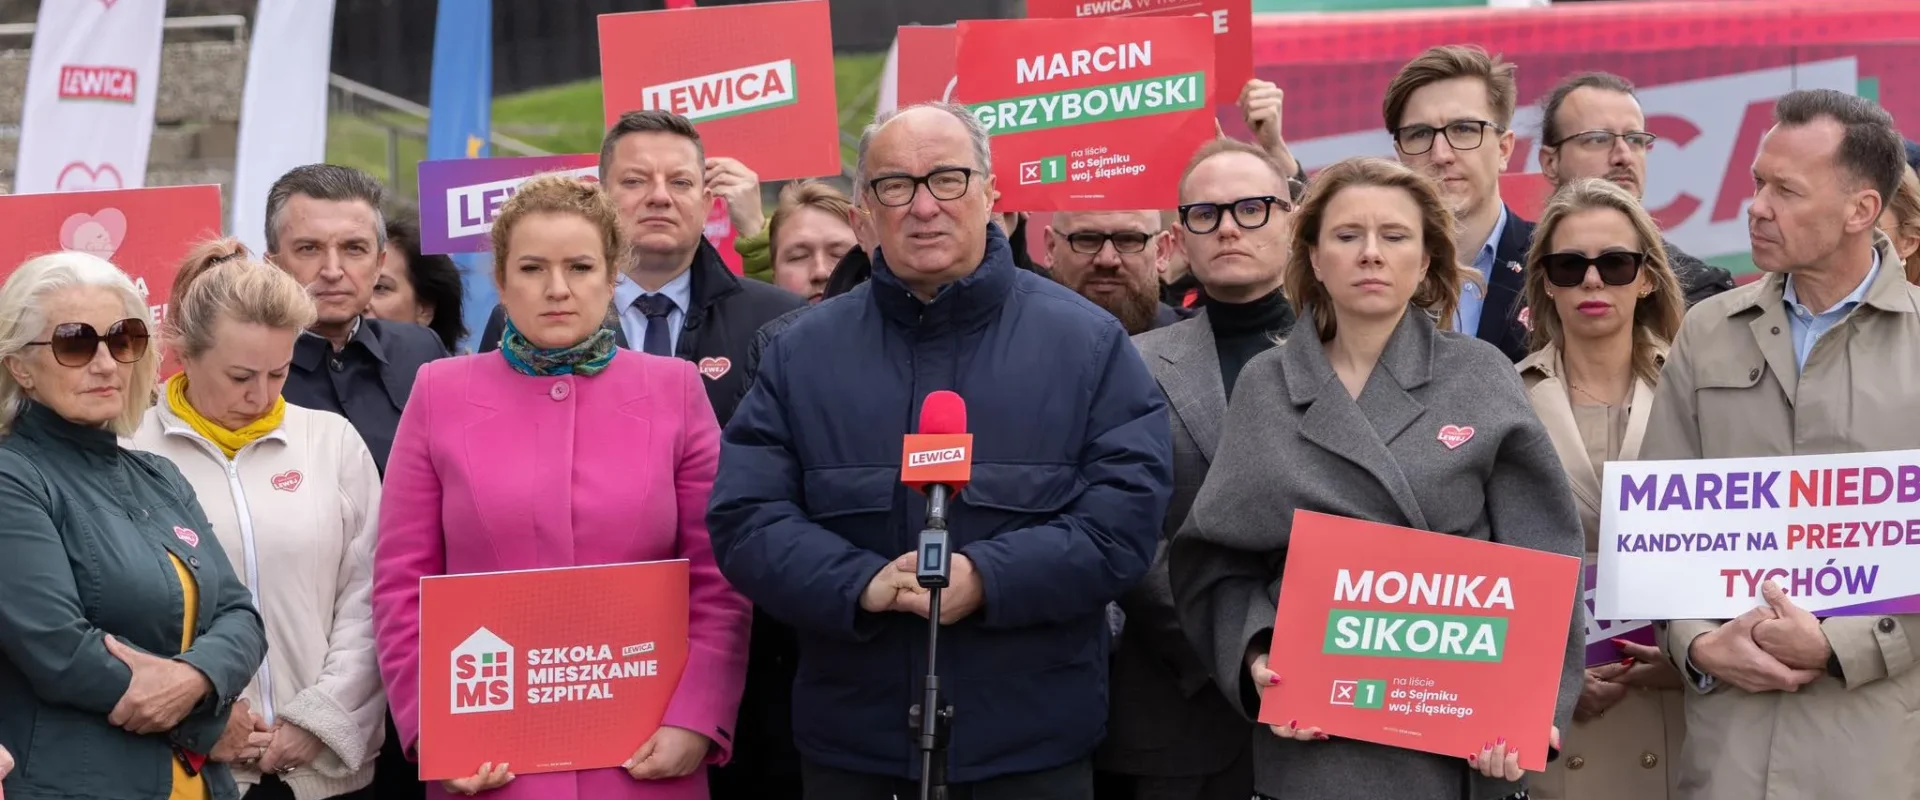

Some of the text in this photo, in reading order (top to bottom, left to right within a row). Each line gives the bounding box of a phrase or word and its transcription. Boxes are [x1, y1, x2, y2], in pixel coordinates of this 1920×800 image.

[1076, 0, 1132, 16] LEWICA
[1016, 40, 1151, 84] MARCIN
[62, 69, 133, 98] LEWICA
[652, 68, 785, 115] LEWICA
[973, 76, 1196, 130] GRZYBOWSKI
[1071, 146, 1107, 157] na liście
[1071, 154, 1130, 169] do Sejmiku
[1049, 160, 1057, 178] 1
[1071, 163, 1146, 182] woj. śląskiego
[912, 449, 961, 464] LEWICA
[1619, 464, 1920, 511] MAREK NIEDB
[1617, 519, 1920, 552] KANDYDAT NA PREZYDE
[1333, 568, 1514, 610] MONIKA
[1335, 616, 1497, 656] SIKORA
[527, 643, 652, 665] SZKOŁA LEWICA
[527, 660, 657, 684] MIESZKANIE
[1393, 677, 1435, 687] na liście
[527, 683, 613, 704] SZPITAL
[1365, 684, 1375, 704] 1
[1391, 689, 1458, 702] do Sejmiku
[1389, 701, 1473, 718] woj. śląskiego
